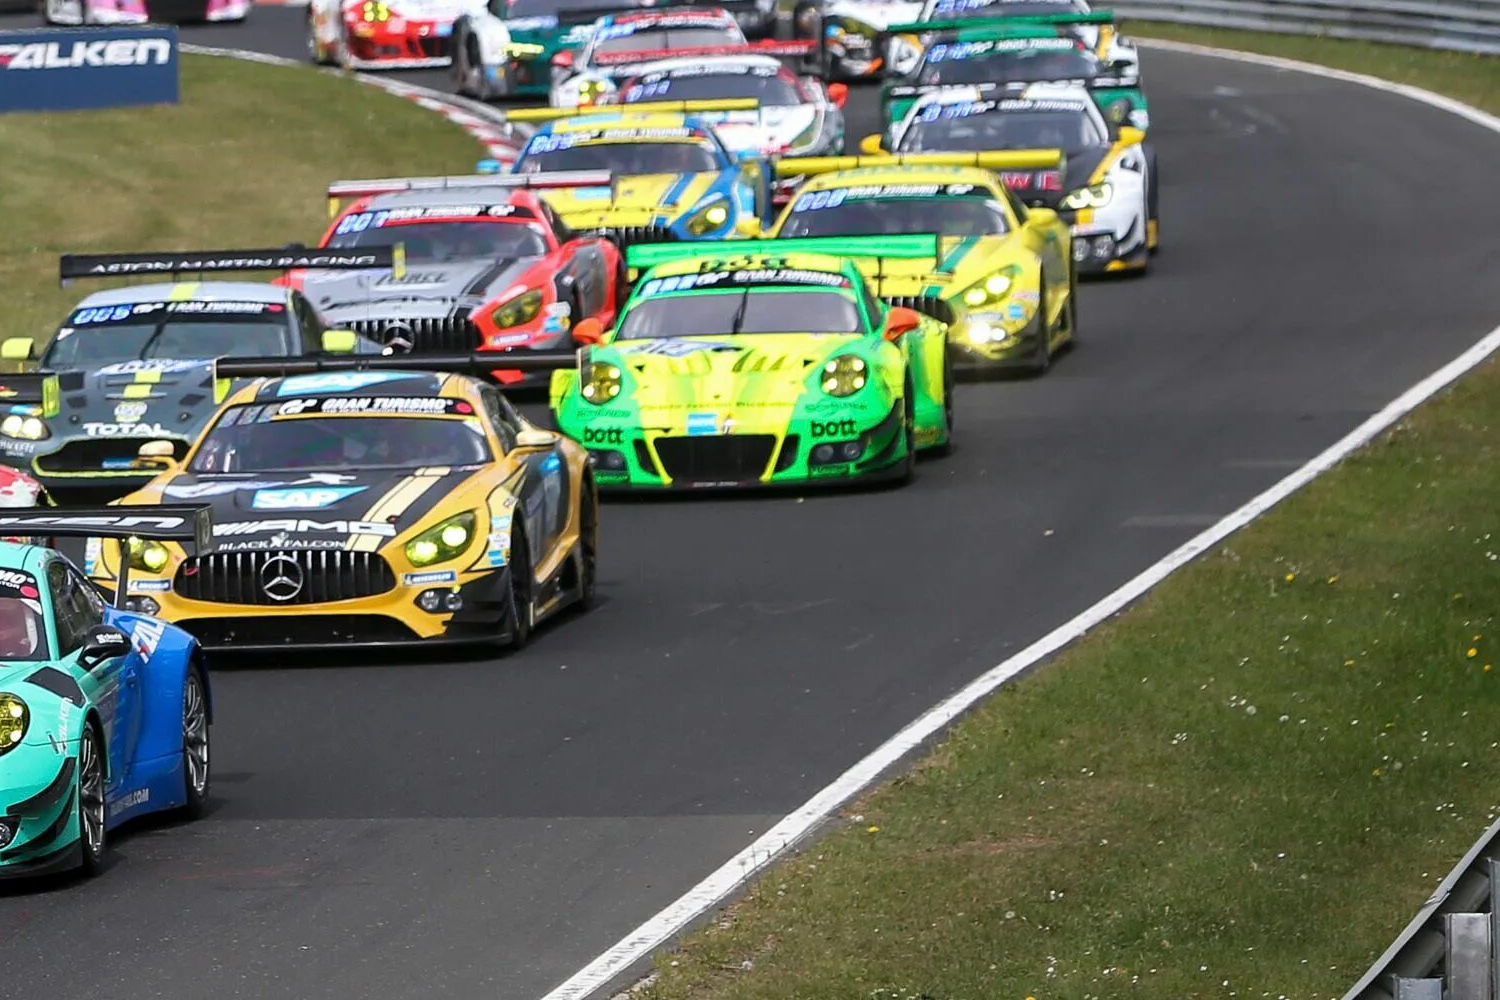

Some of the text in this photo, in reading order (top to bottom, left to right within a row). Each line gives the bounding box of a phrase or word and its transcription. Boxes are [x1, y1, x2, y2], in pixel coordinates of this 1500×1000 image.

[89, 254, 377, 274] ASTON MARTIN RACING
[72, 305, 132, 325] 005
[320, 398, 370, 410] GRAN
[82, 422, 172, 437] TOTAL
[583, 427, 623, 445] bott
[810, 419, 858, 438] bott
[256, 490, 340, 508] SAP
[218, 540, 347, 551] BLACK FALCON
